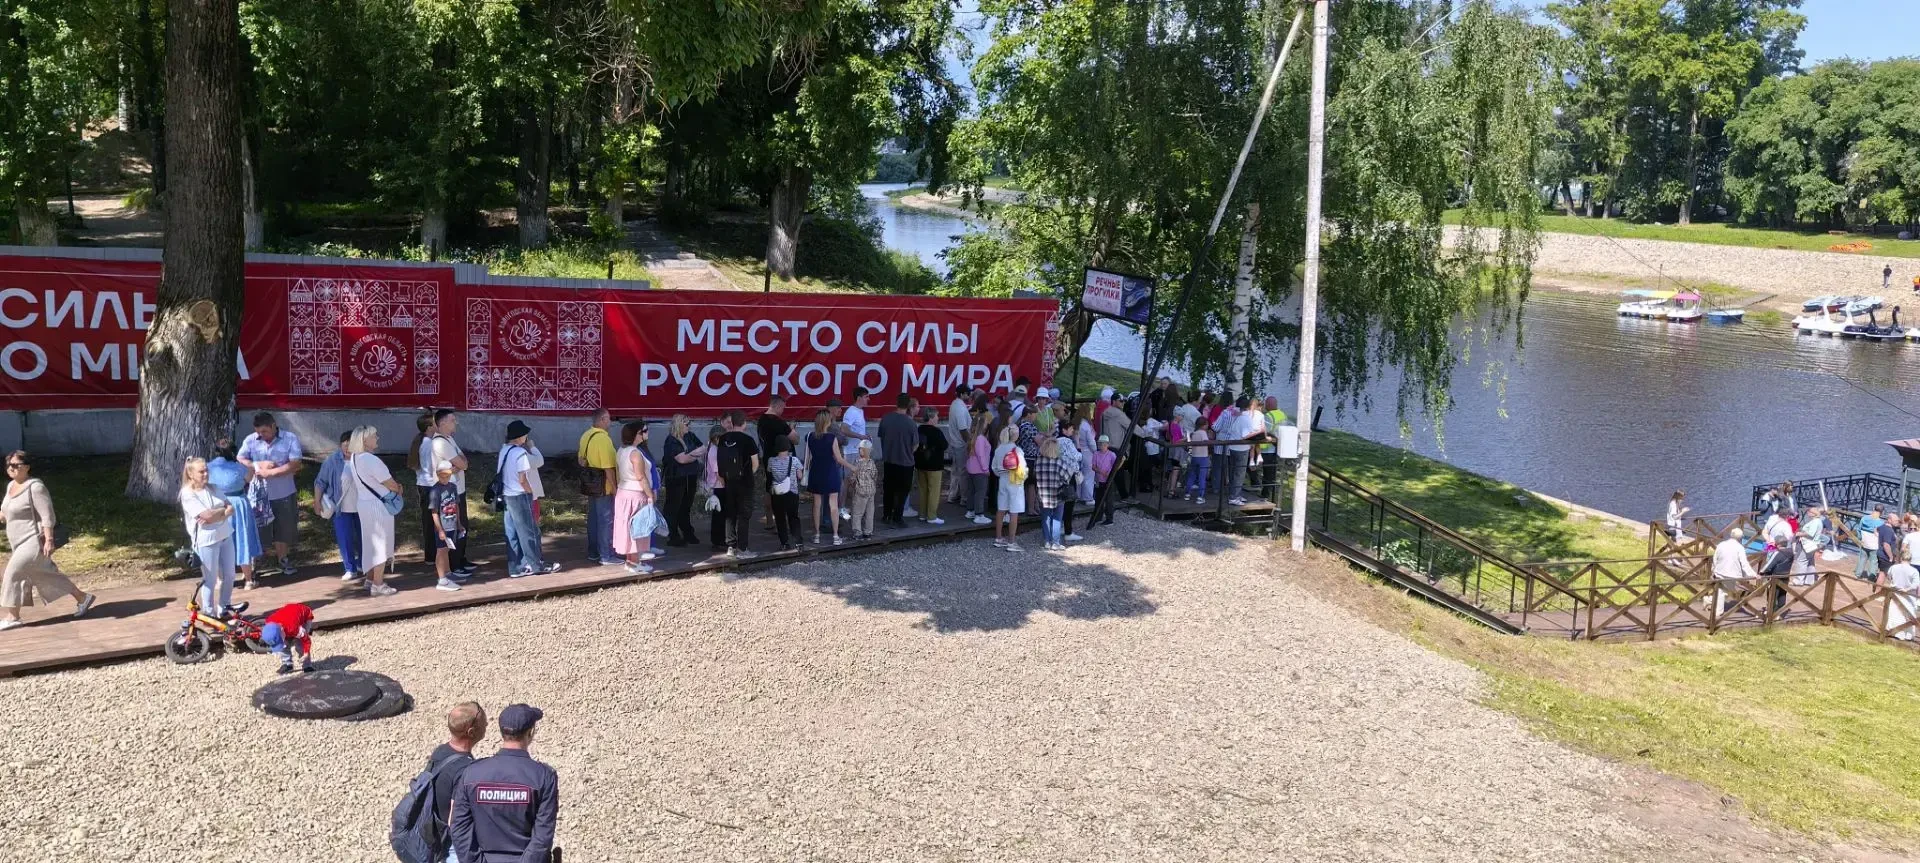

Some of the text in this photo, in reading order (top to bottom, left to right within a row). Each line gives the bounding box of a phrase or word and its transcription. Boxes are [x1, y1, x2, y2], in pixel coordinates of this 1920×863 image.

[1096, 277, 1120, 289] РЕЧНЫЕ
[1086, 285, 1120, 300] ПРОГУЛКИ
[677, 319, 979, 354] МЕСТО СИЛЫ
[639, 363, 1014, 396] РУССКОГО МИРА
[480, 790, 527, 801] ПОЛИЦИЯ
